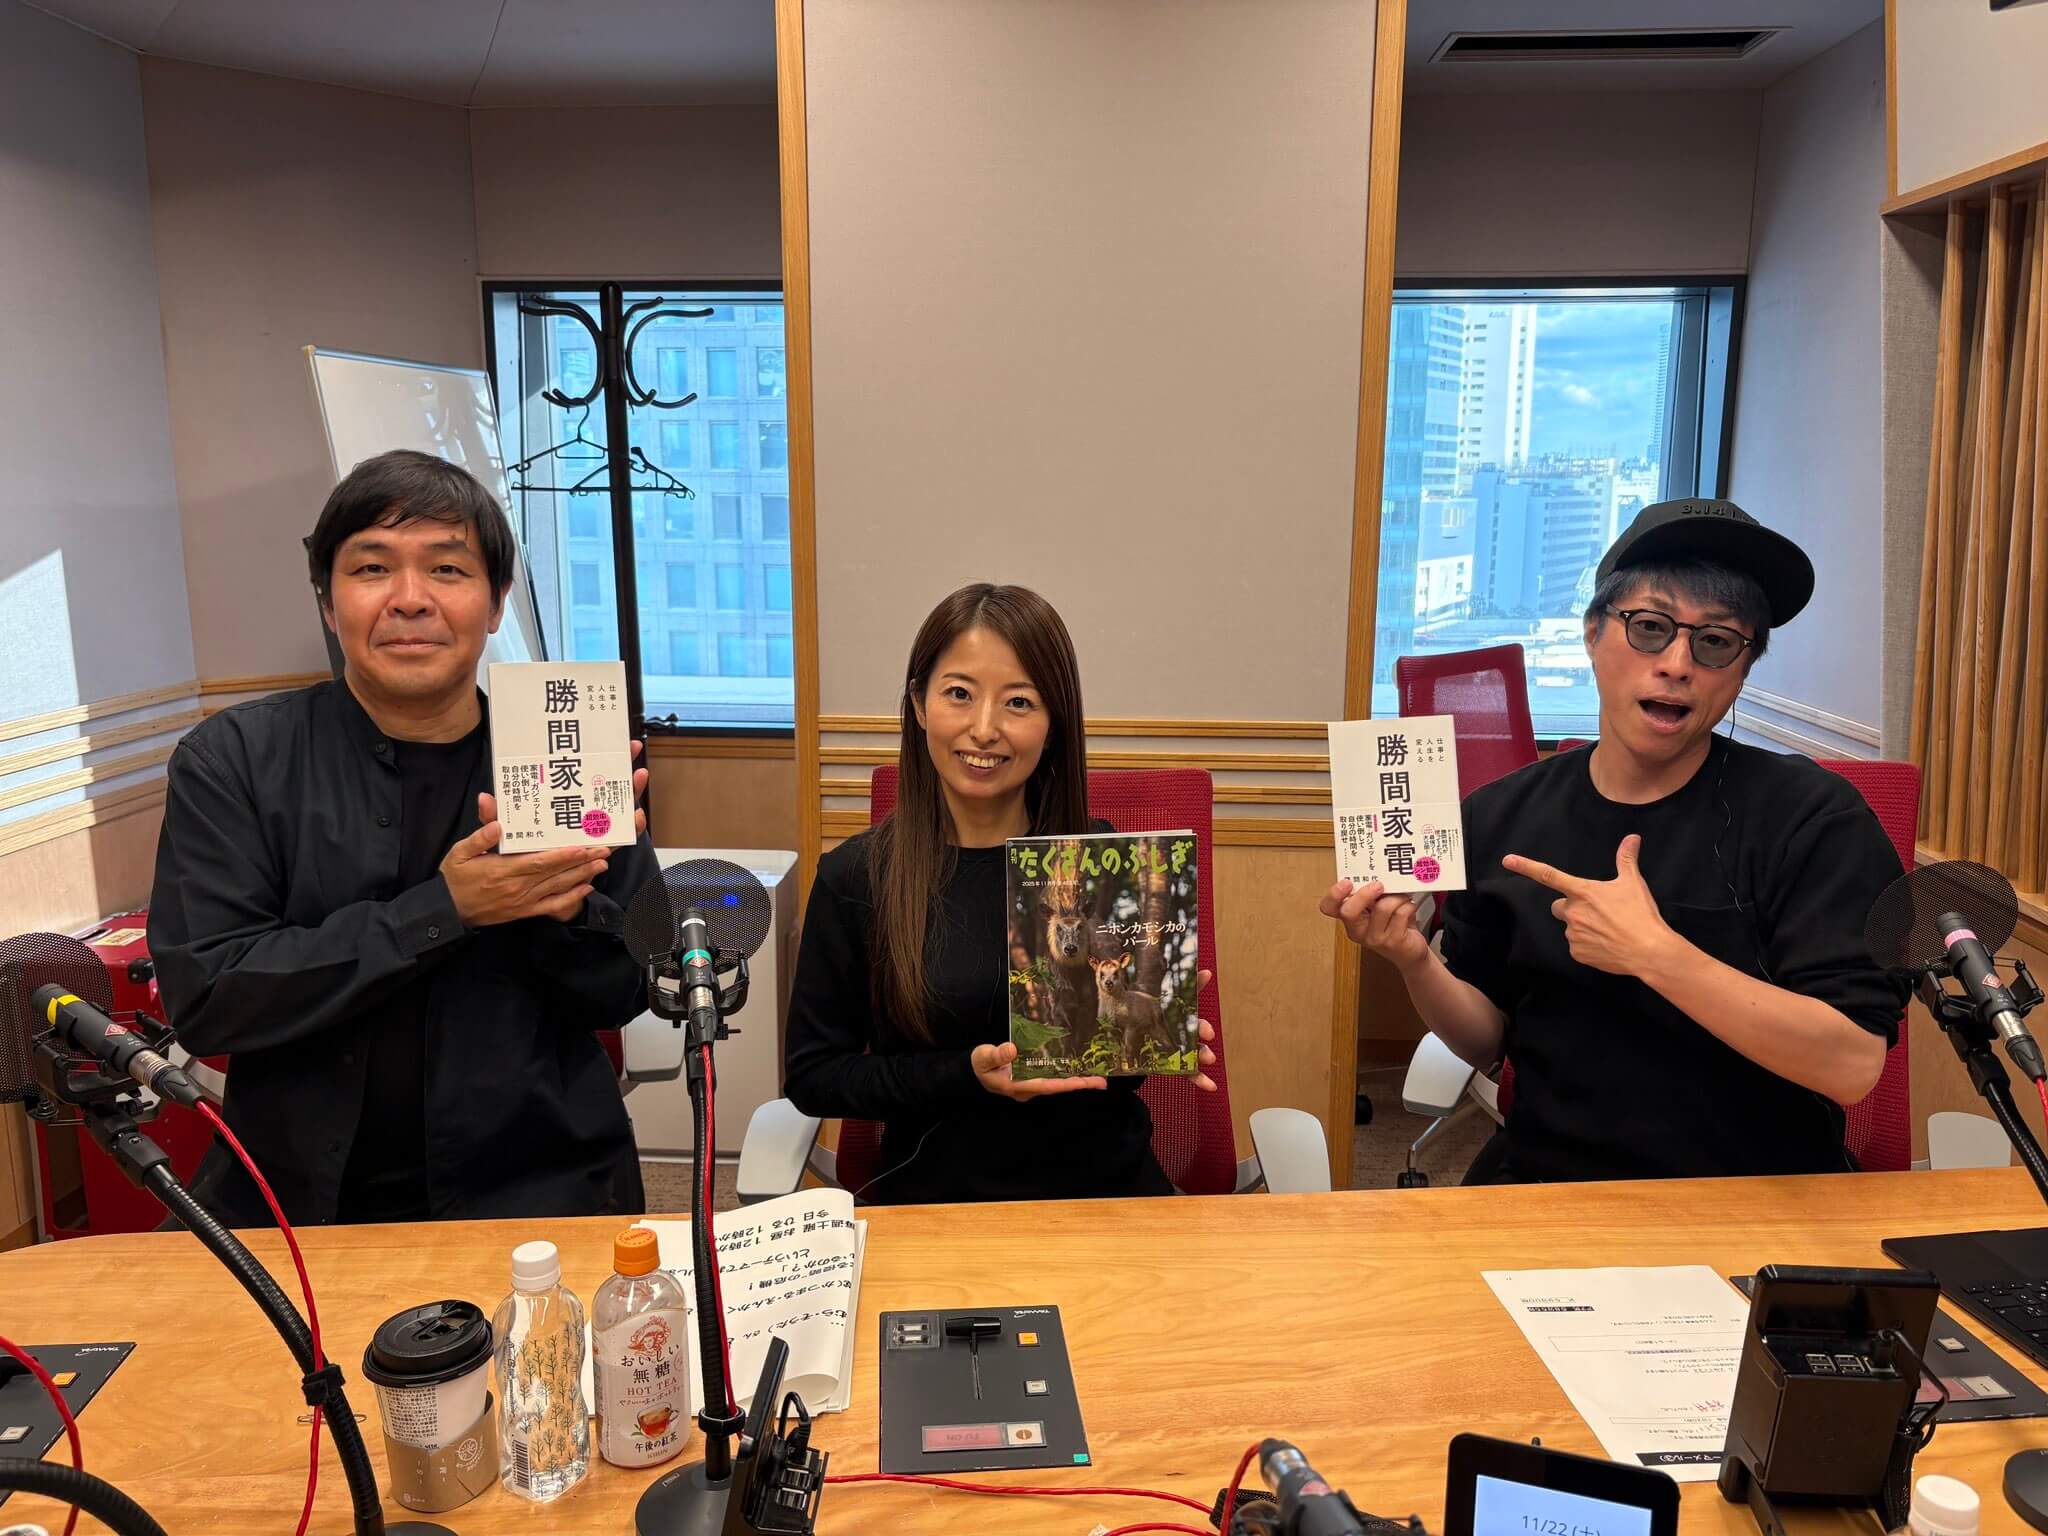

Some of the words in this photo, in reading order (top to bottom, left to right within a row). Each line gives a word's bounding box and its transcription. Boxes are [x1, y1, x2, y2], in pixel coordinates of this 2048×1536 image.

[586, 685, 595, 711] 変える
[598, 684, 607, 711] 人生を
[609, 684, 617, 711] 仕事と
[544, 678, 585, 830] 勝間家電
[1415, 739, 1424, 763] 変える
[1426, 738, 1434, 763] 人生を
[1436, 737, 1445, 763] 仕事と
[502, 766, 510, 796] 取り戻せ
[511, 765, 522, 811] 自分の時間を
[520, 765, 530, 801] 使い倒して
[1376, 733, 1416, 875] 勝間家電
[505, 830, 545, 840] 勝間和代
[1348, 815, 1358, 857] 自分の時間を
[1010, 847, 1018, 864] 月刊
[1019, 838, 1194, 879] たくさんのふしぎ
[1095, 920, 1187, 936] ニホンカモシカの
[771, 1216, 794, 1228] ひる
[803, 1209, 830, 1220] 今日
[769, 1228, 796, 1241] お昼
[620, 1343, 680, 1368] おいしい
[633, 1361, 671, 1384] 無糖
[627, 1386, 652, 1396] HOT
[656, 1378, 679, 1391] TEA
[634, 1431, 679, 1453] 午後の紅茶
[1521, 1514, 1568, 1535] 11/22
